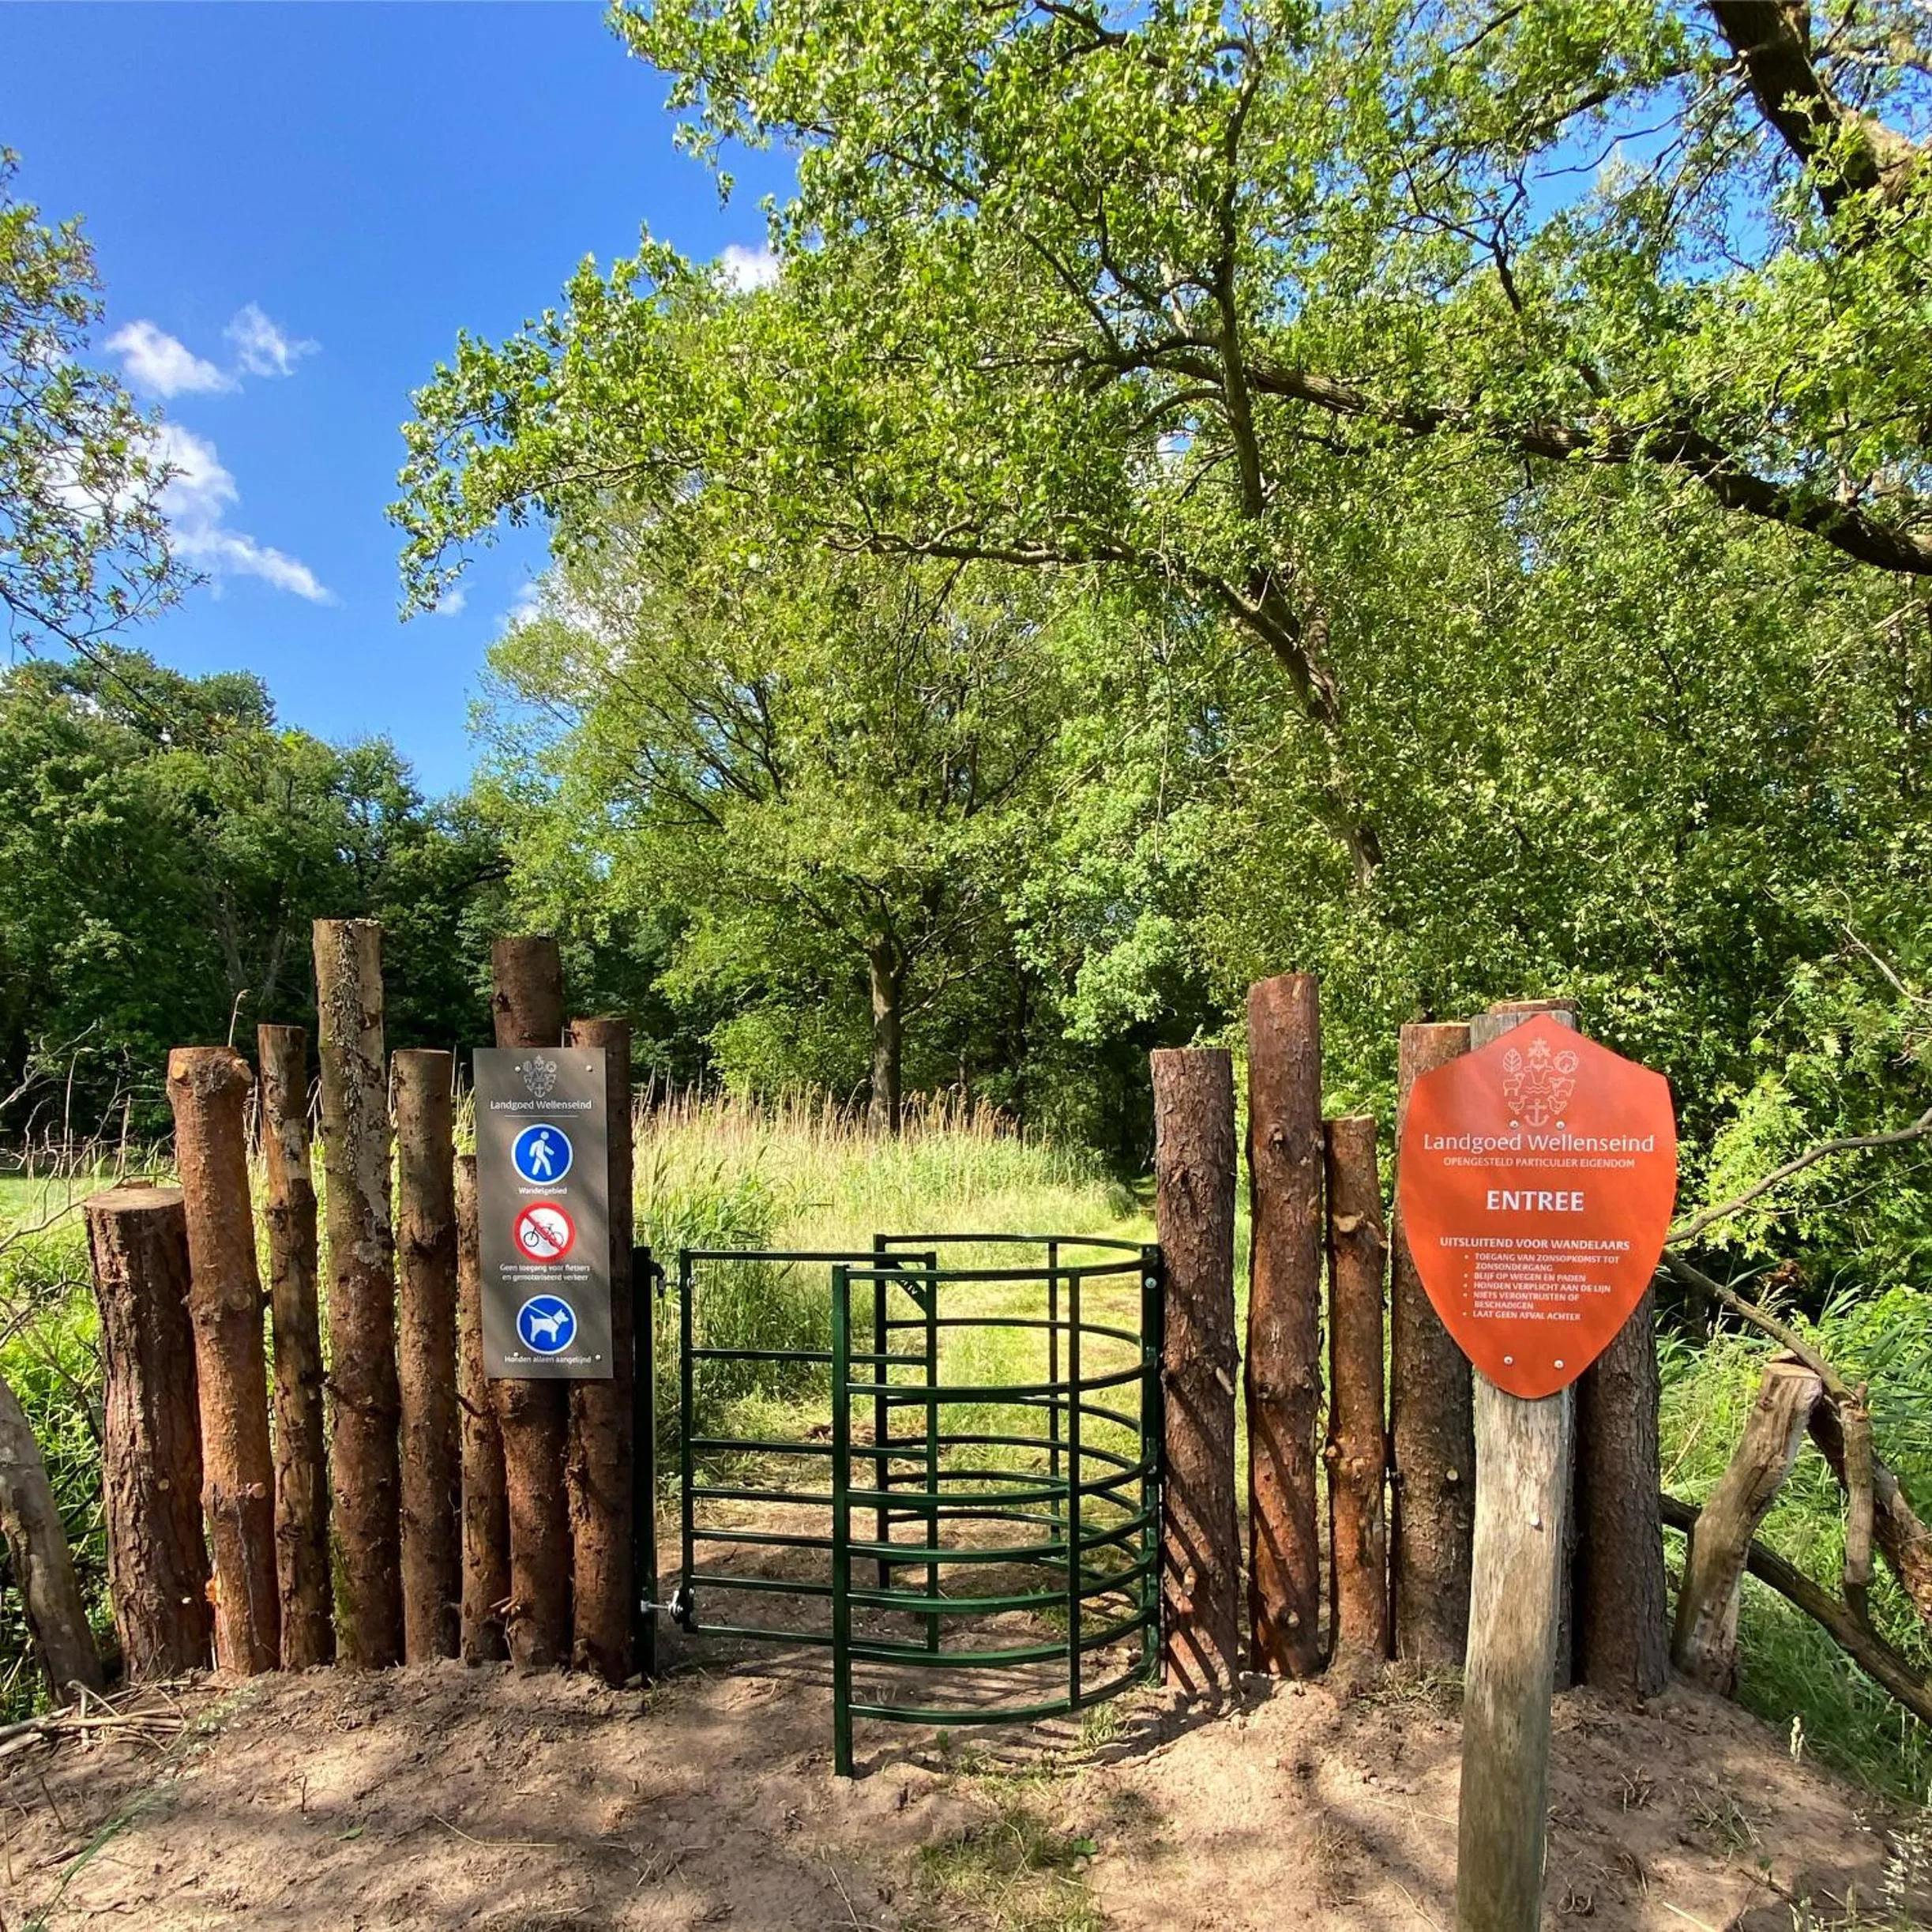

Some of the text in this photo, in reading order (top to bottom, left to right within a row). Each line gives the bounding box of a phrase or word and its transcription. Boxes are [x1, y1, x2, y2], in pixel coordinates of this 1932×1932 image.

[490, 1099, 592, 1111] Landgoed Wellenseind
[1424, 1133, 1655, 1152] Landgoed Wellenseind
[1443, 1157, 1635, 1167] OPENGESTELD PARTICULIER EIGENDOM
[518, 1186, 567, 1195] Wandelgebied
[1487, 1190, 1584, 1212] ENTREE
[1440, 1237, 1630, 1250] UITSLUITEND VOOR WANDELAARS
[1475, 1253, 1516, 1261] TOEGANG
[1536, 1254, 1601, 1263] ZONSOPKOMST
[1475, 1263, 1553, 1272] ZONSONDERGANG
[1513, 1283, 1558, 1291] VERPLICHT
[1594, 1285, 1611, 1294] LIJN
[1499, 1292, 1566, 1301] VERONTRUSTEN
[1475, 1300, 1534, 1309] BESCHADIGEN
[555, 1356, 592, 1365] aangelijnd
